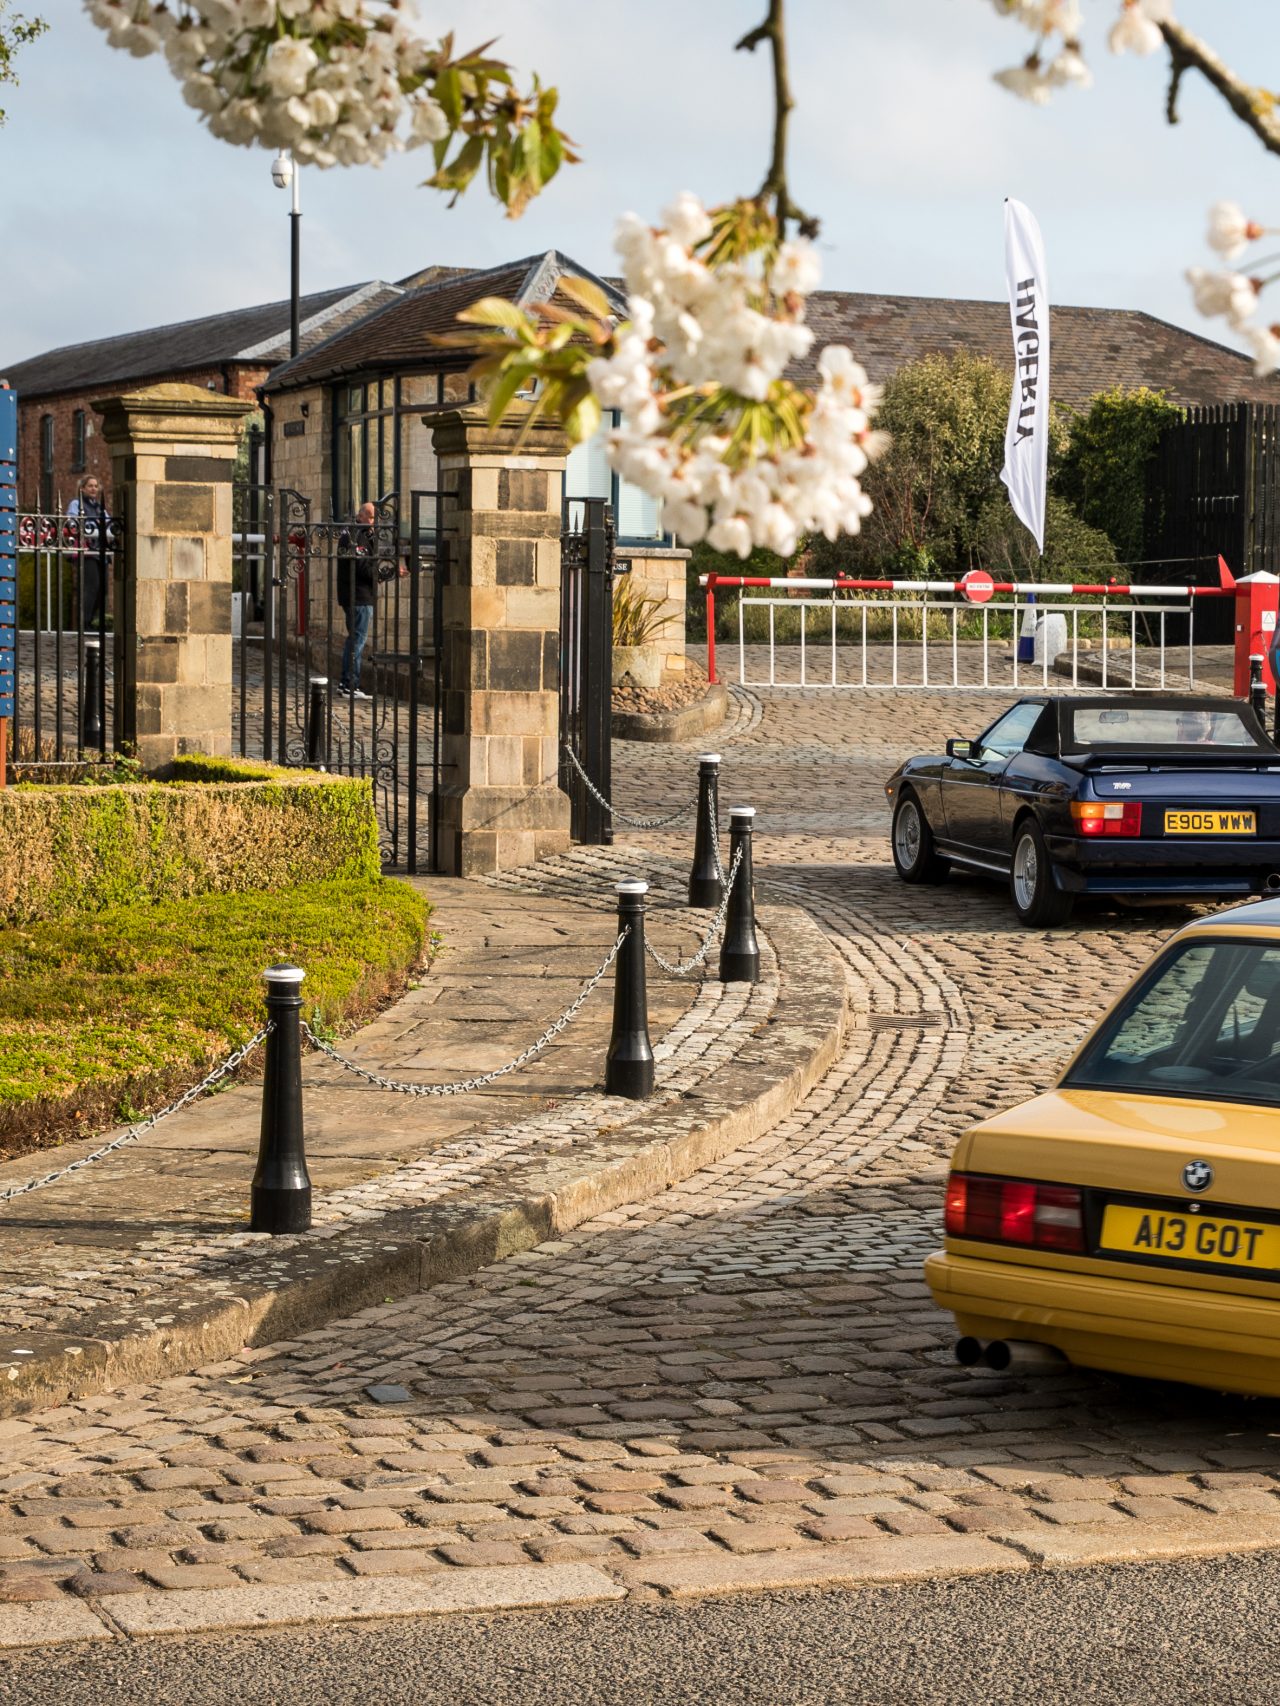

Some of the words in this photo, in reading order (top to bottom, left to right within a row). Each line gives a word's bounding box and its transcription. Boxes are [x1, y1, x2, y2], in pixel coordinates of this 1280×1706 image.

[1167, 814, 1214, 830] E905
[1219, 815, 1253, 831] WWW
[1133, 1214, 1187, 1251] A13
[1195, 1222, 1264, 1261] GOT
